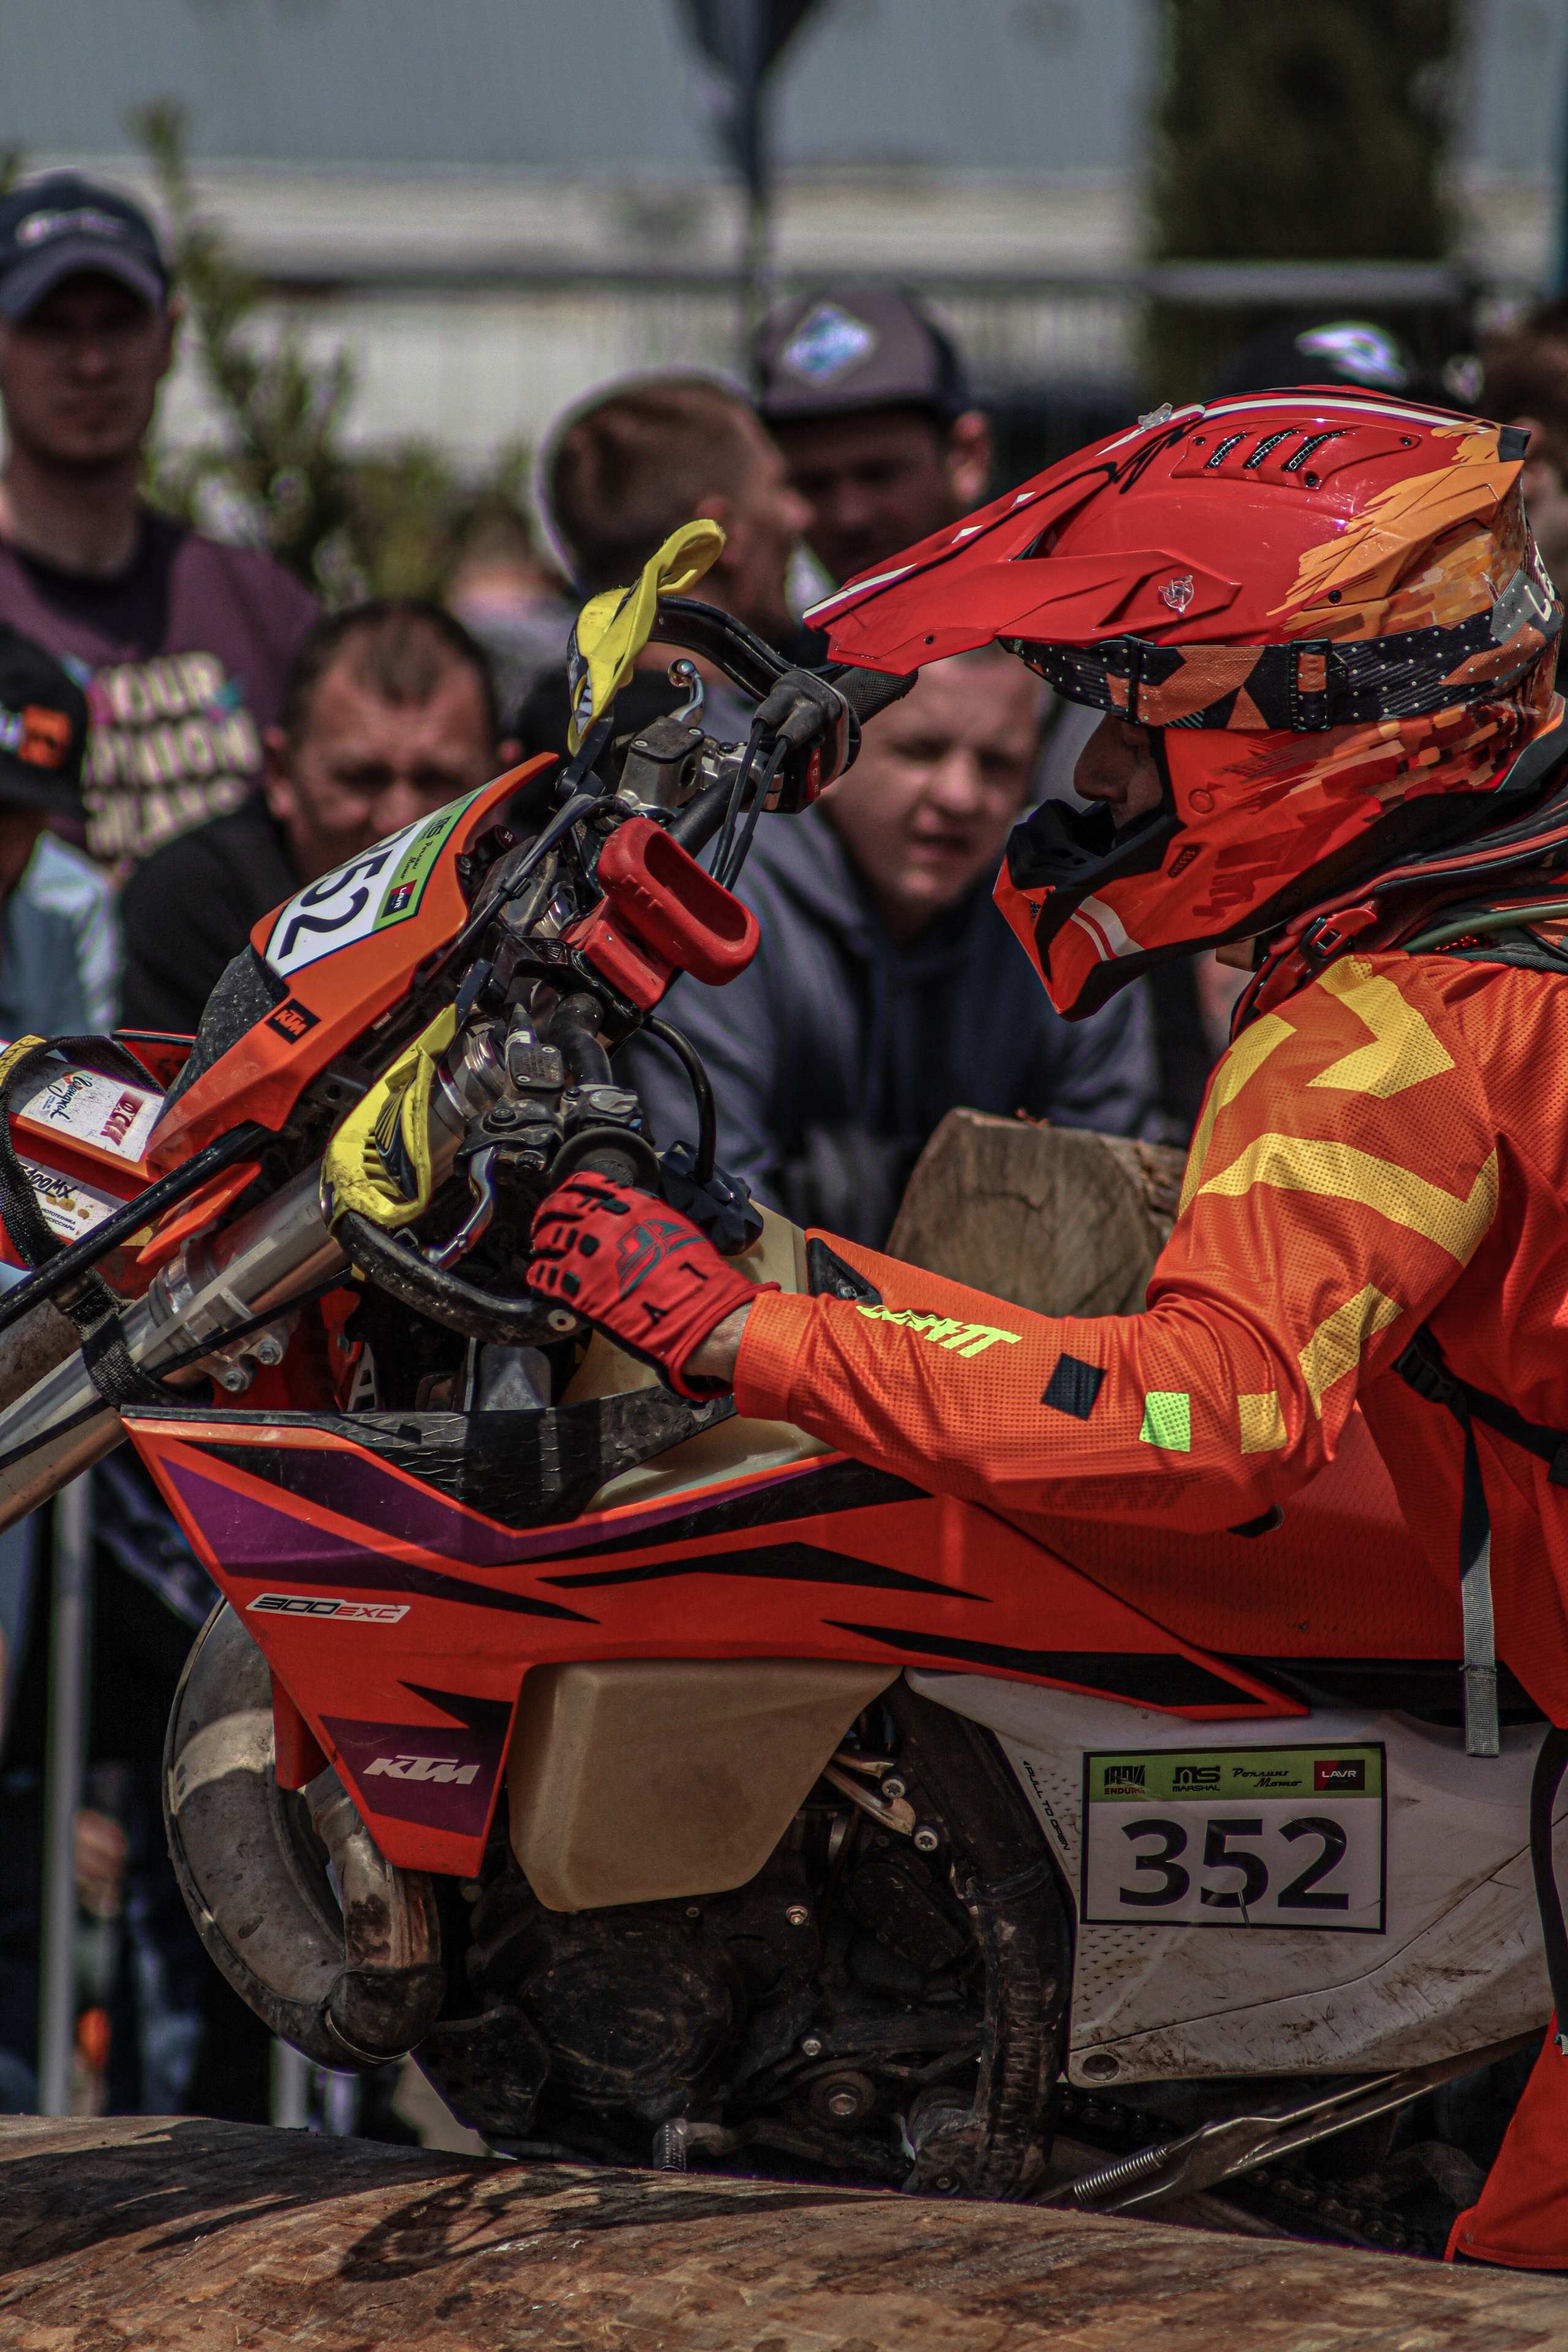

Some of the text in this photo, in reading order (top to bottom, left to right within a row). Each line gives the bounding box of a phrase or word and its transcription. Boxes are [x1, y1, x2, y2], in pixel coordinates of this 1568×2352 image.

[393, 886, 407, 909] LAVR
[273, 1009, 307, 1036] KTM
[362, 1755, 480, 1785] KTM
[1253, 1777, 1303, 1787] Мото
[1025, 1766, 1071, 1851] PULL TO OPEN
[1119, 1817, 1349, 1910] 352
